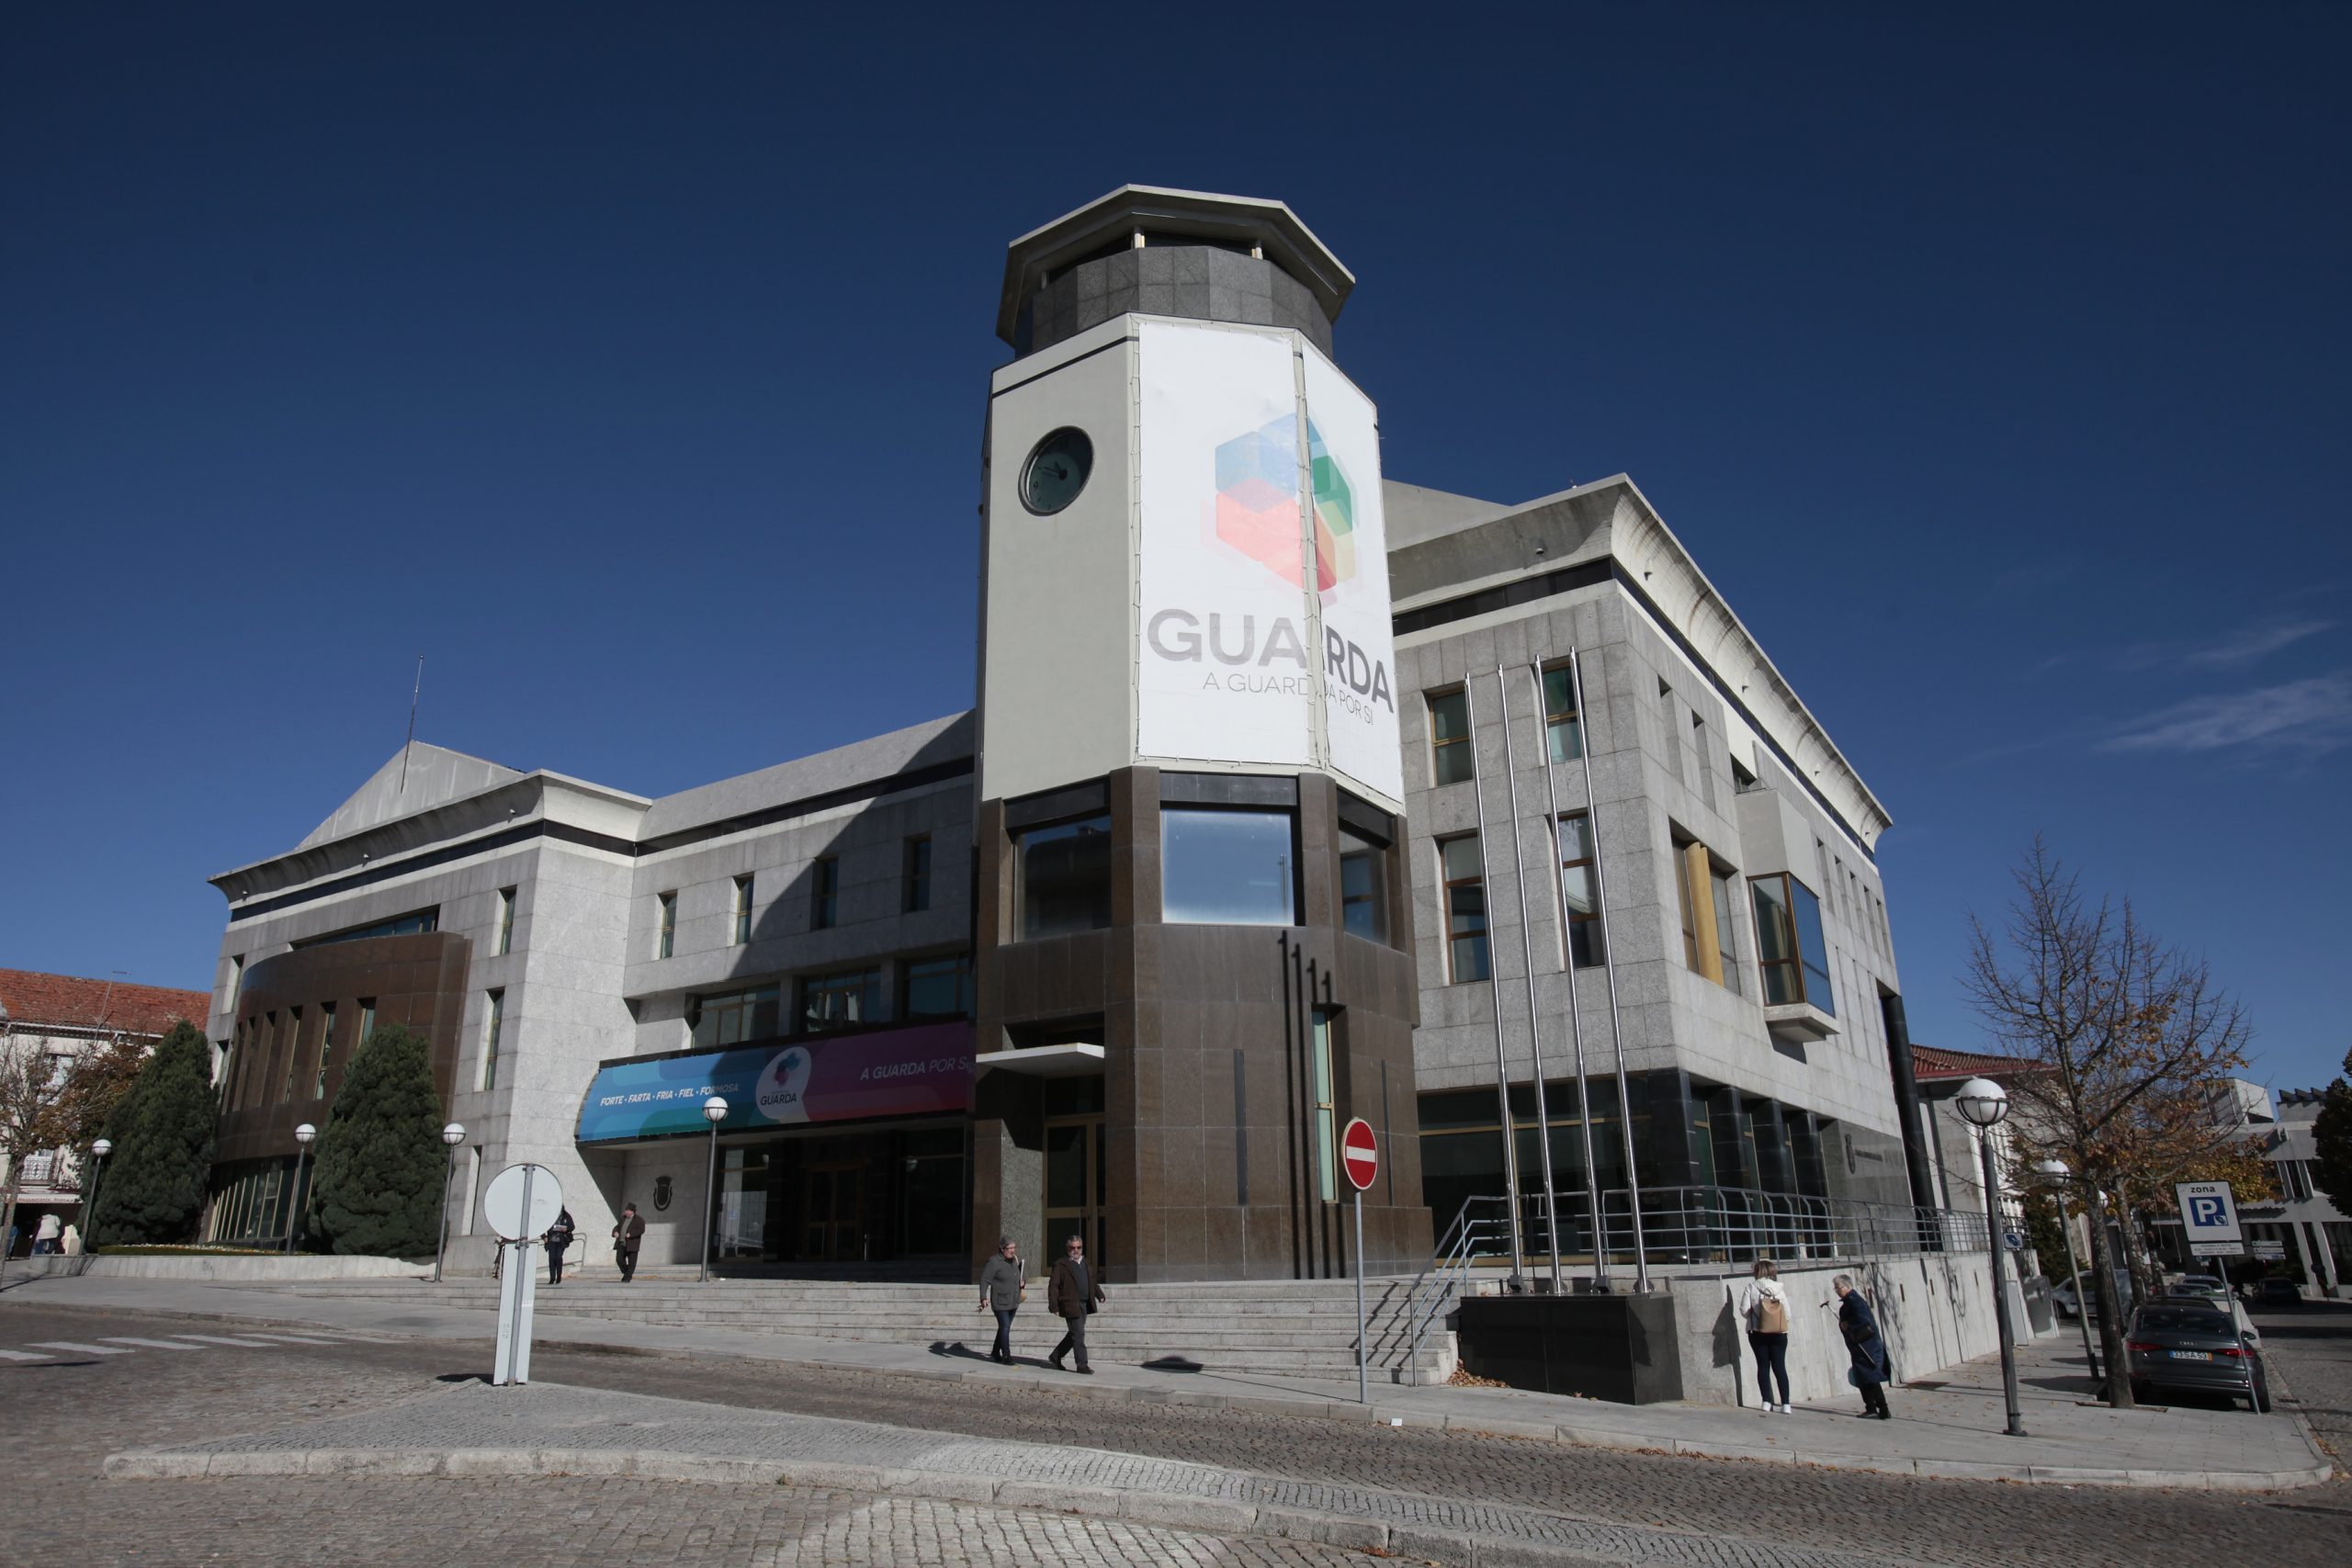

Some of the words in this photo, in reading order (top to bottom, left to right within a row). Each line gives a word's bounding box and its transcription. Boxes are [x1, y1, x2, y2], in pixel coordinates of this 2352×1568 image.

[1148, 608, 1394, 713] GUARDA
[1203, 671, 1220, 691] A
[1227, 673, 1337, 704] GUARDA
[1340, 690, 1362, 718] POR
[1364, 705, 1374, 725] SI
[860, 1067, 869, 1081] A
[872, 1063, 925, 1079] GUARDA
[929, 1057, 956, 1073] POR
[600, 1095, 624, 1107] FORTE
[628, 1092, 650, 1103] FARTA
[656, 1090, 673, 1101] FRIA
[679, 1088, 695, 1099] FIEL
[699, 1083, 739, 1095] FORMOSA
[760, 1092, 797, 1107] GUARDA
[2196, 1199, 2217, 1223] P
